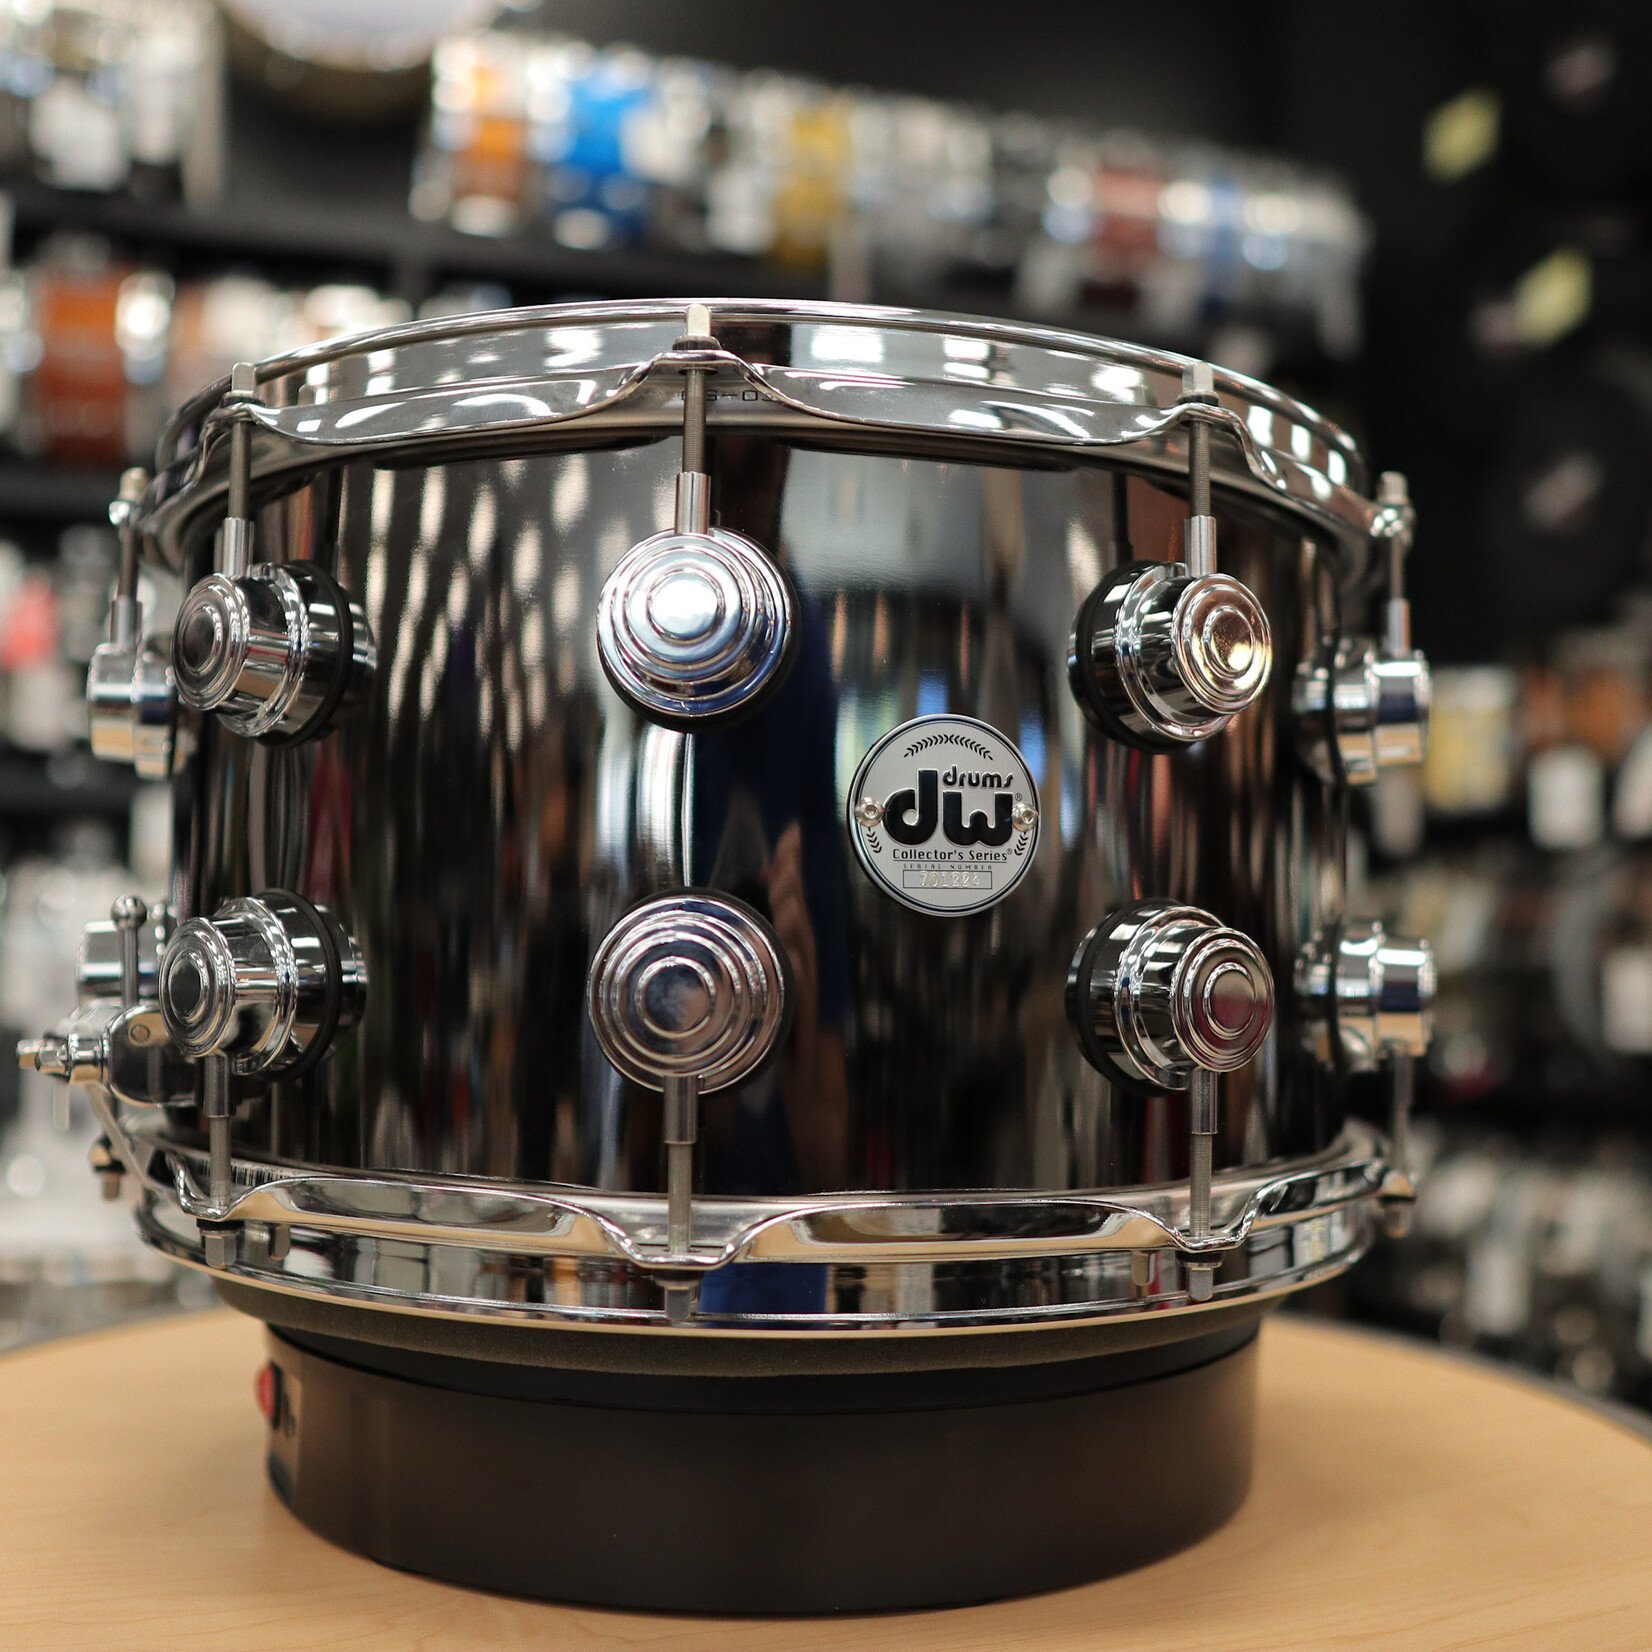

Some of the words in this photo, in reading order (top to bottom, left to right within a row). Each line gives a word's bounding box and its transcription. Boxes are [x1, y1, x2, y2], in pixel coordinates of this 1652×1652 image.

[942, 765, 1014, 789] drums
[885, 769, 1013, 846] dw
[893, 848, 964, 860] Collector's
